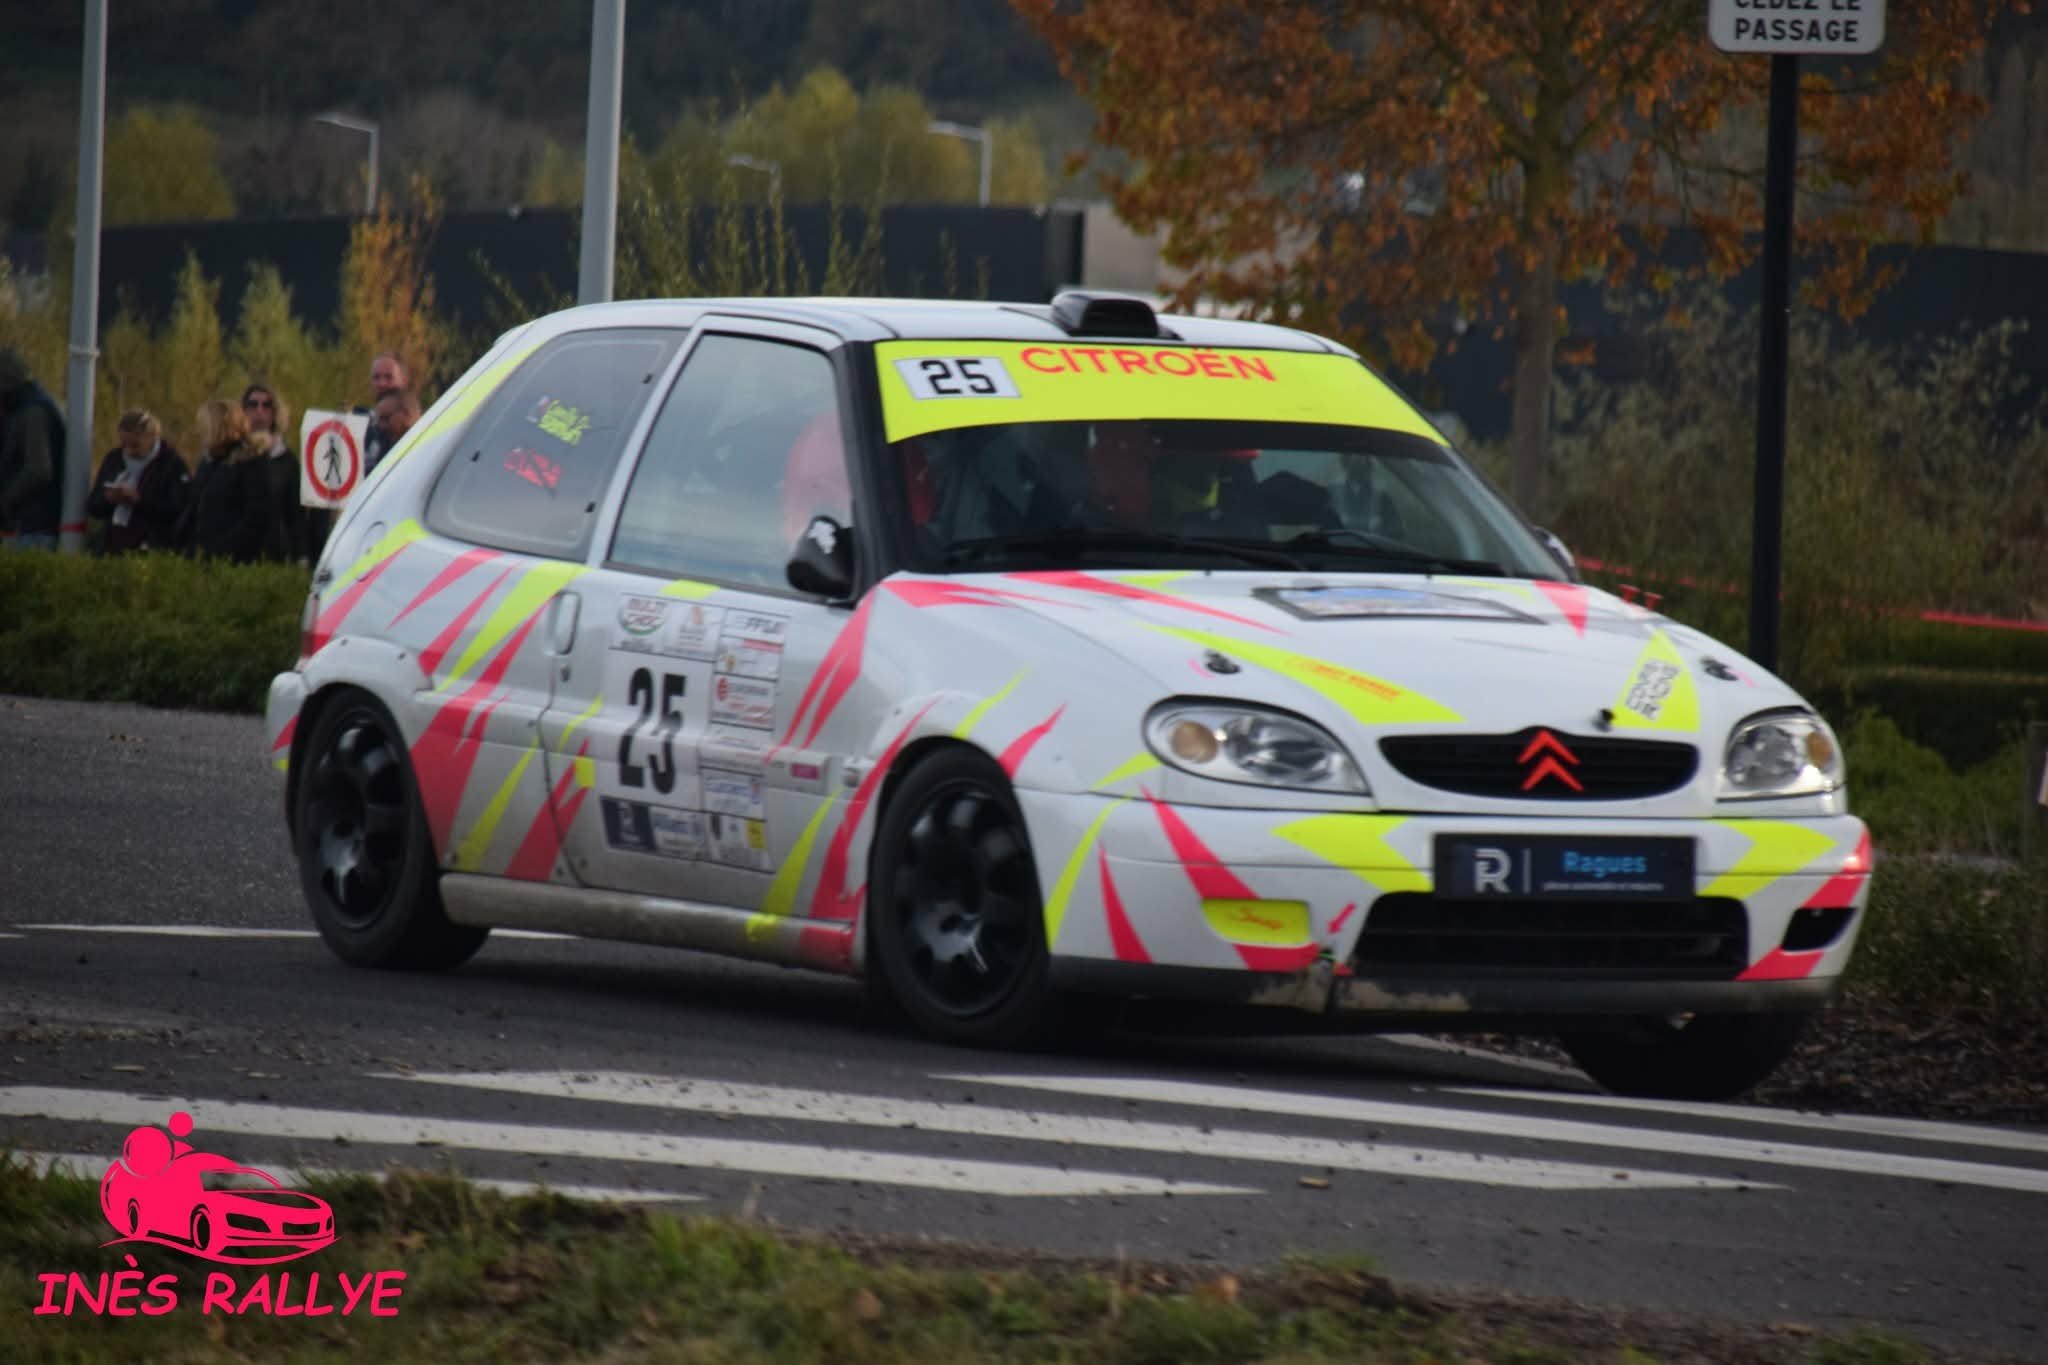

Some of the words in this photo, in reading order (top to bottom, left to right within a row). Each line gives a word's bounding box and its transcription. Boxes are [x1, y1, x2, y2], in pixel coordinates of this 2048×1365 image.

[1734, 18, 1859, 42] PASSAGE
[919, 359, 998, 395] 25
[1020, 346, 1277, 382] CITROËN
[618, 666, 688, 794] 25
[1562, 851, 1648, 878] Ragues
